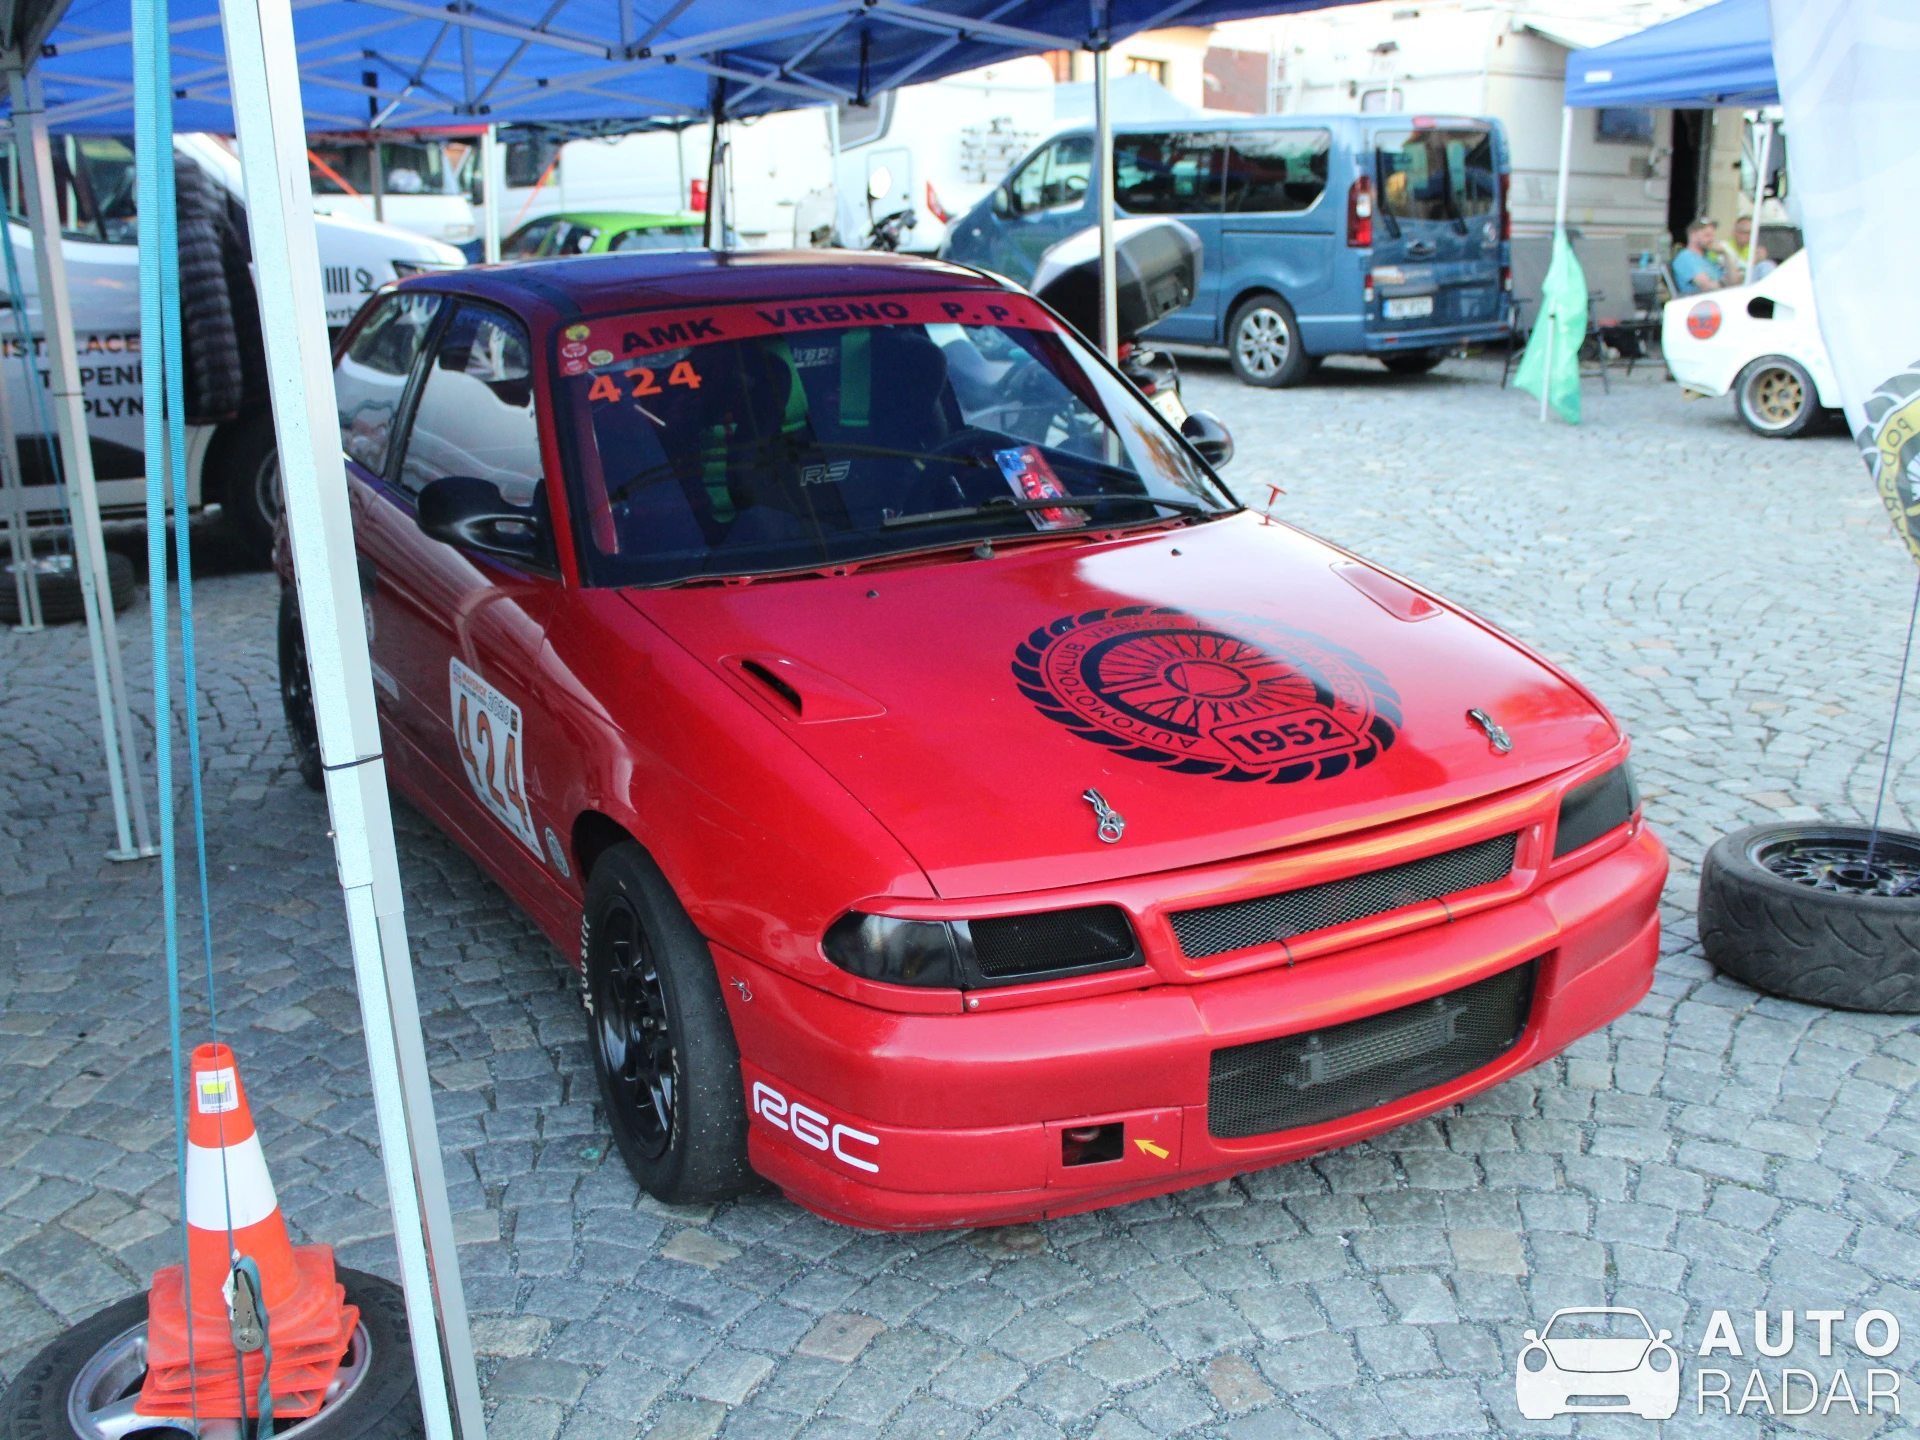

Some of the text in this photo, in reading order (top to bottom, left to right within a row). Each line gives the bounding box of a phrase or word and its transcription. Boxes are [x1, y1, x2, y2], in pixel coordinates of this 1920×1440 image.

[622, 316, 725, 354] AMK
[756, 301, 909, 328] VRBNO
[588, 360, 703, 403] 424
[1055, 643, 1198, 749] AUTOMOTOKLUB
[1229, 717, 1344, 756] 1952
[457, 693, 531, 834] 424
